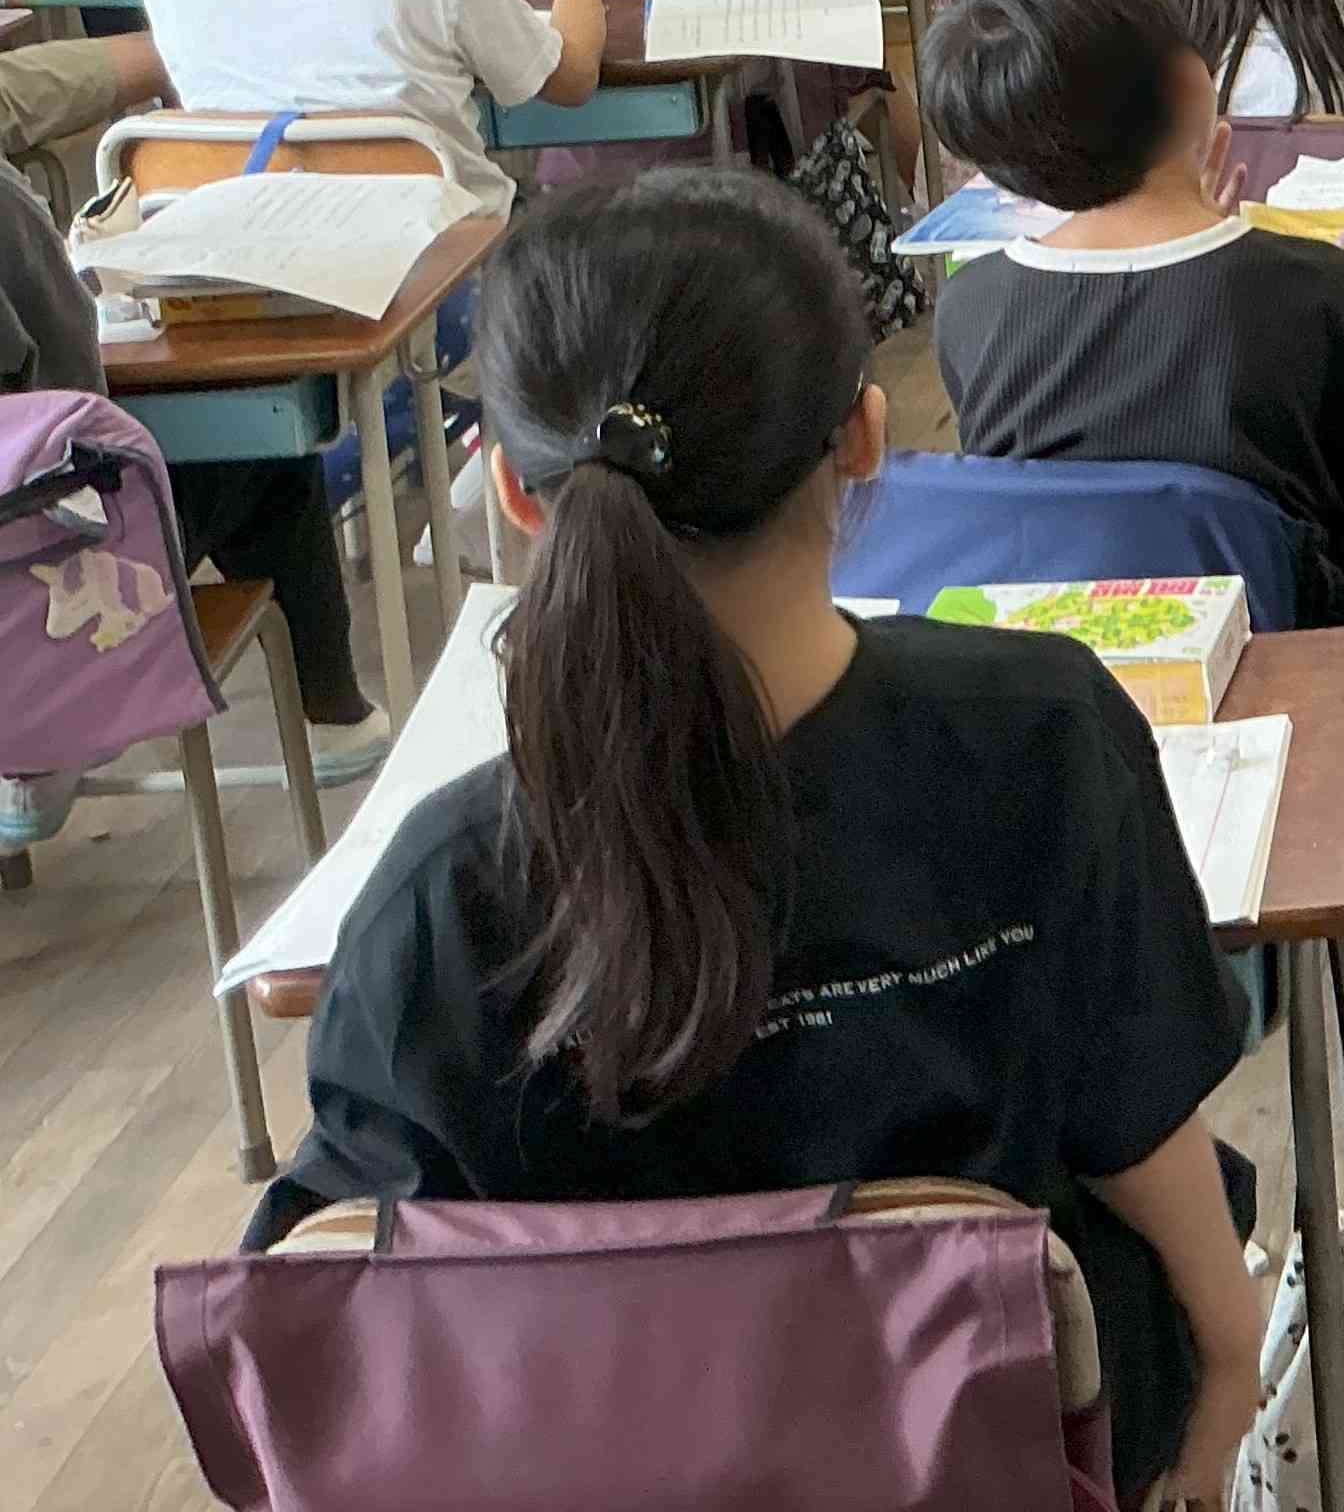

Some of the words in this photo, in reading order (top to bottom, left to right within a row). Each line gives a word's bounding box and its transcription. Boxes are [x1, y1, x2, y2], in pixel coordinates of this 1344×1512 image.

[857, 972, 903, 995] VERY
[908, 956, 960, 985] MUCH
[1000, 924, 1034, 945] YOU
